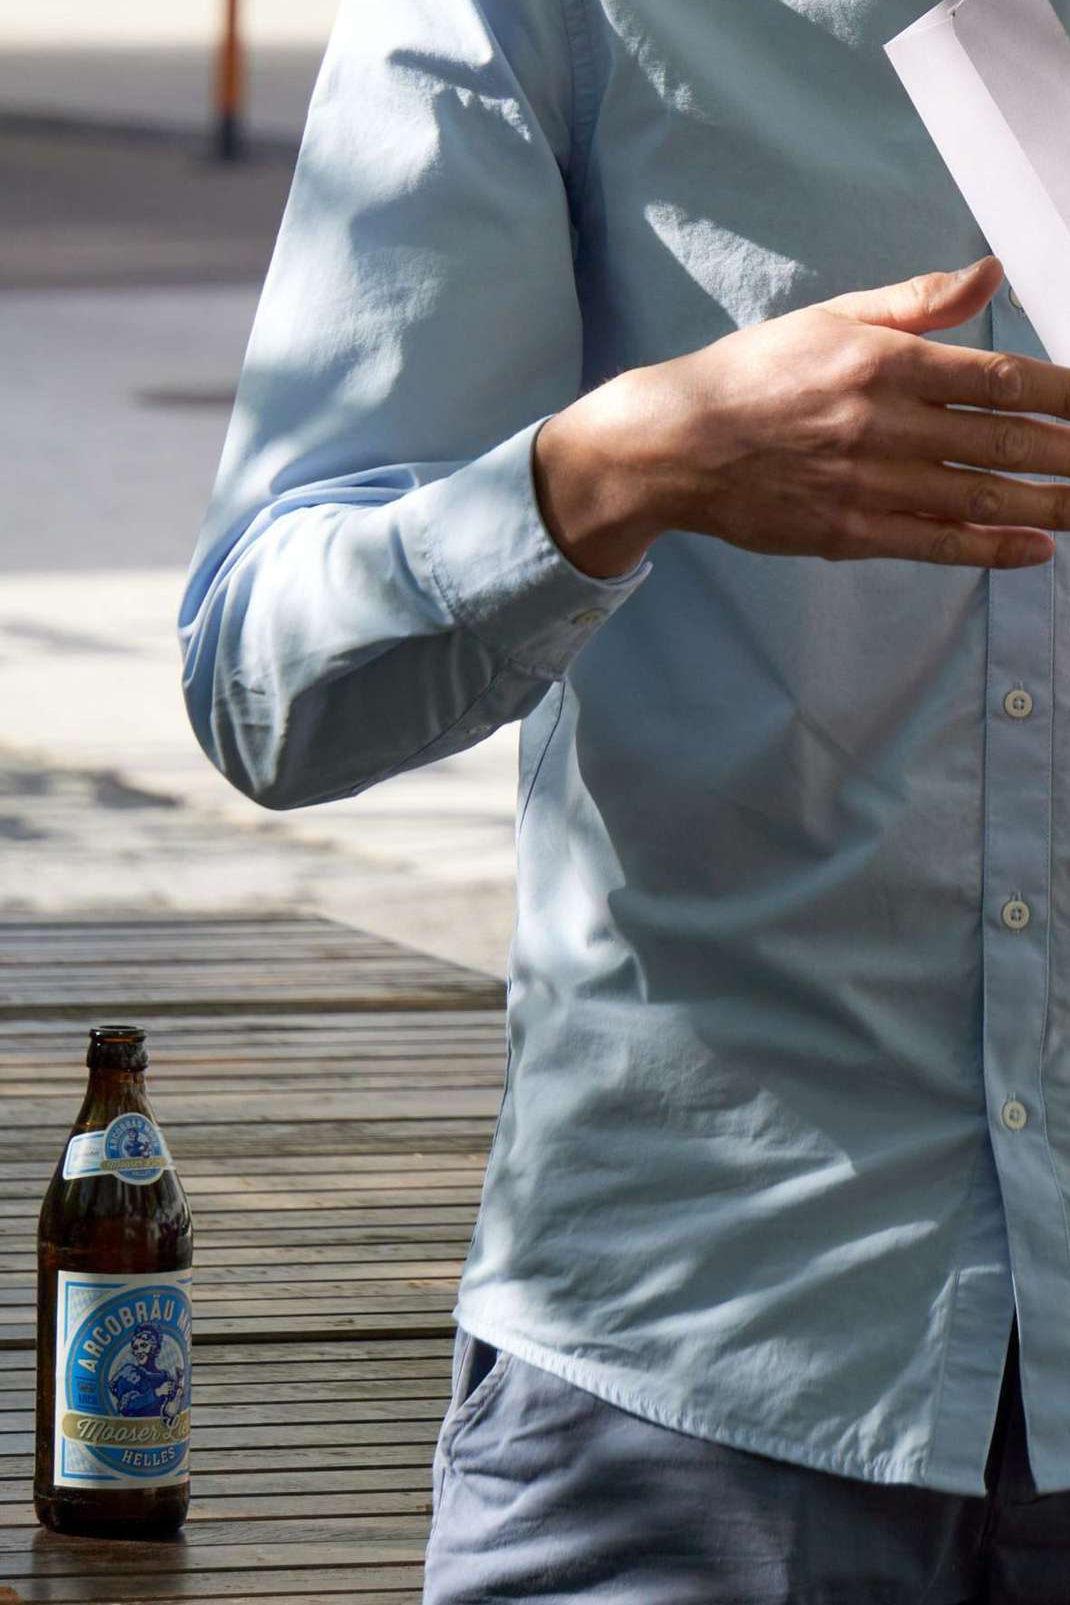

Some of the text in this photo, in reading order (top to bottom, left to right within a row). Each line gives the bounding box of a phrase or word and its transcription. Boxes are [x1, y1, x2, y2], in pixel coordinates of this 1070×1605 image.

[78, 1294, 176, 1373] ARCOBRÄU
[77, 1417, 160, 1444] Mooser
[122, 1447, 175, 1467] HELLES
